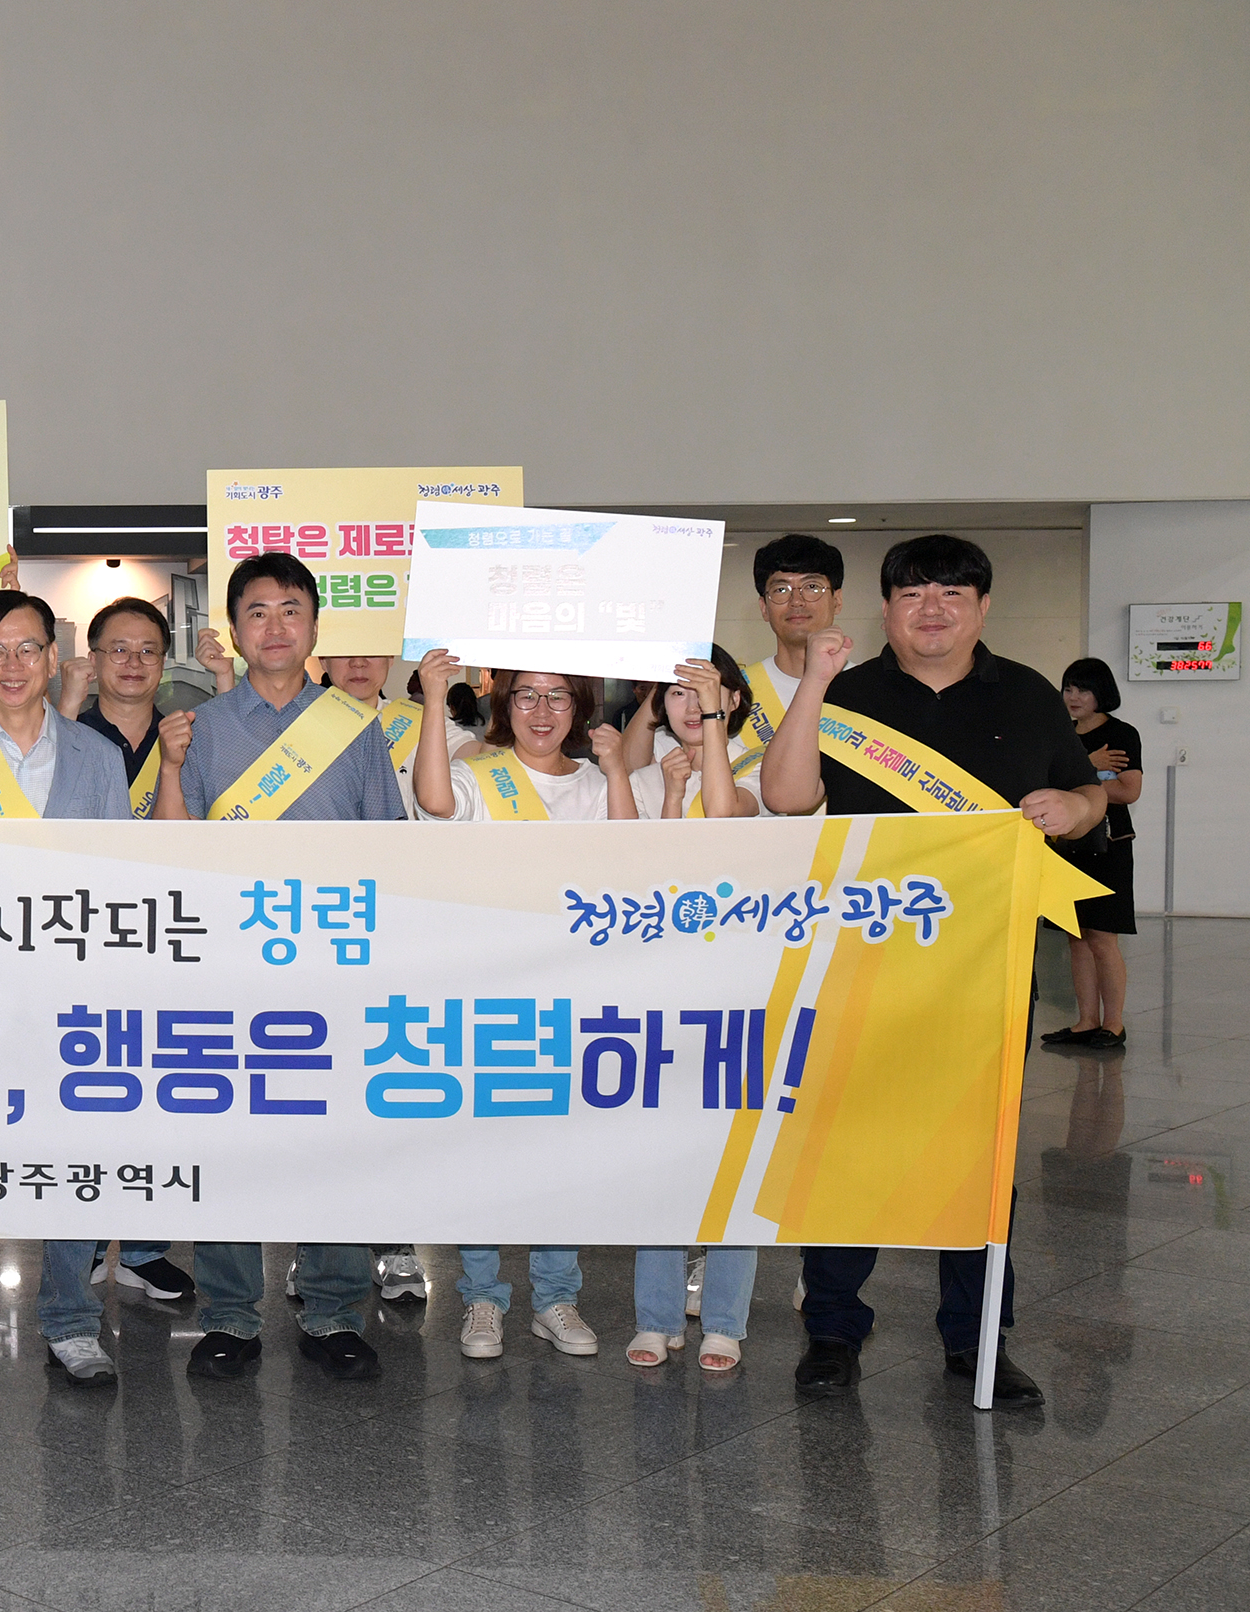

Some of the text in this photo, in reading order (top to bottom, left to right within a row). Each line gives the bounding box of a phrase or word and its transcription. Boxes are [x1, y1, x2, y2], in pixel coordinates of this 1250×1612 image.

[257, 485, 284, 500] 광주
[477, 483, 501, 497] 광주
[227, 523, 415, 560] 청탁은 제로
[468, 530, 521, 547] 청렴으로
[527, 529, 554, 544] 가는
[488, 563, 587, 597] 청렴은
[487, 600, 586, 634] 마음의
[1197, 641, 1213, 651] 66
[863, 739, 920, 782] 친절로
[238, 878, 377, 966] 청렴
[840, 880, 947, 941] 광주
[56, 1004, 333, 1116] 행동은
[363, 994, 818, 1119] 청렴하게!
